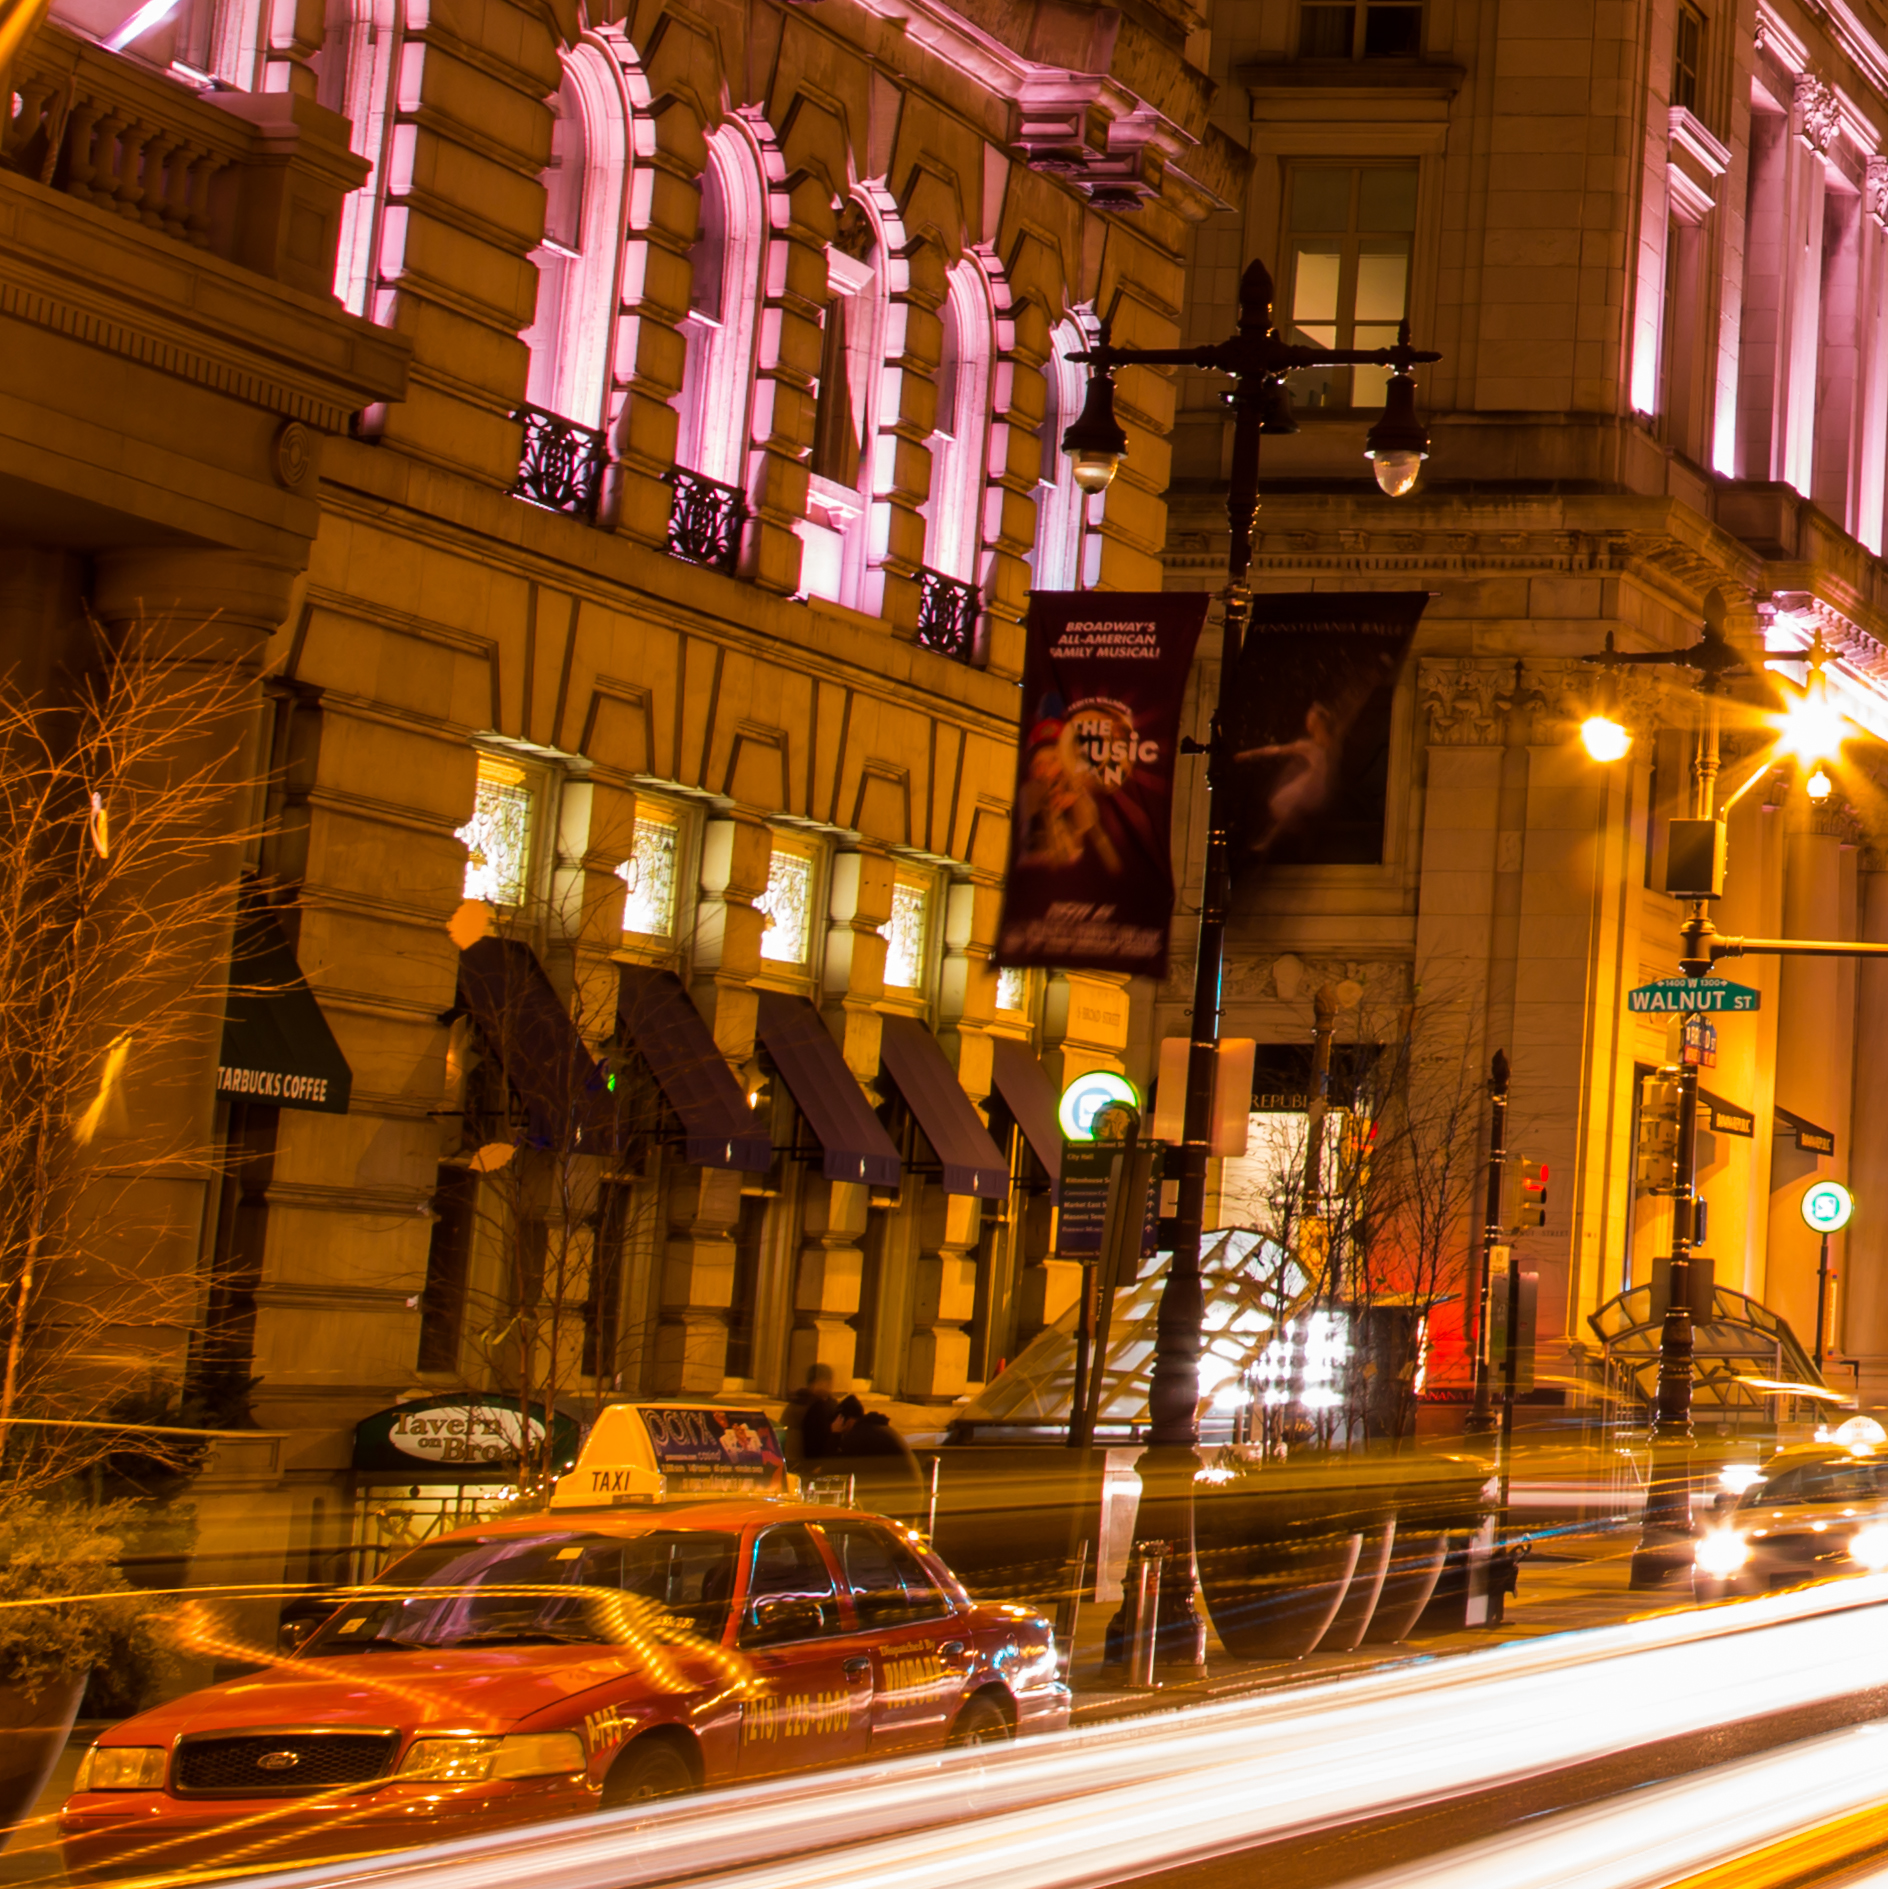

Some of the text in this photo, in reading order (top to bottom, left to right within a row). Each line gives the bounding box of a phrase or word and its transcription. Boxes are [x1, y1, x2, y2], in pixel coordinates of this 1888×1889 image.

[1066, 622, 1156, 632] BROADWAY'S
[1058, 634, 1157, 645] ALL-AMERICAN
[1096, 647, 1160, 658] MUSICAL!
[1665, 978, 1720, 988] 1400 W 1300
[1632, 991, 1752, 1010] WALNUT ST
[217, 1066, 328, 1102] TARBUCKS COFFEE
[1067, 1153, 1080, 1161] City
[392, 1413, 502, 1436] Tavern
[418, 1437, 442, 1449] on
[592, 1471, 631, 1492] TAXI
[743, 1694, 779, 1747] (215)
